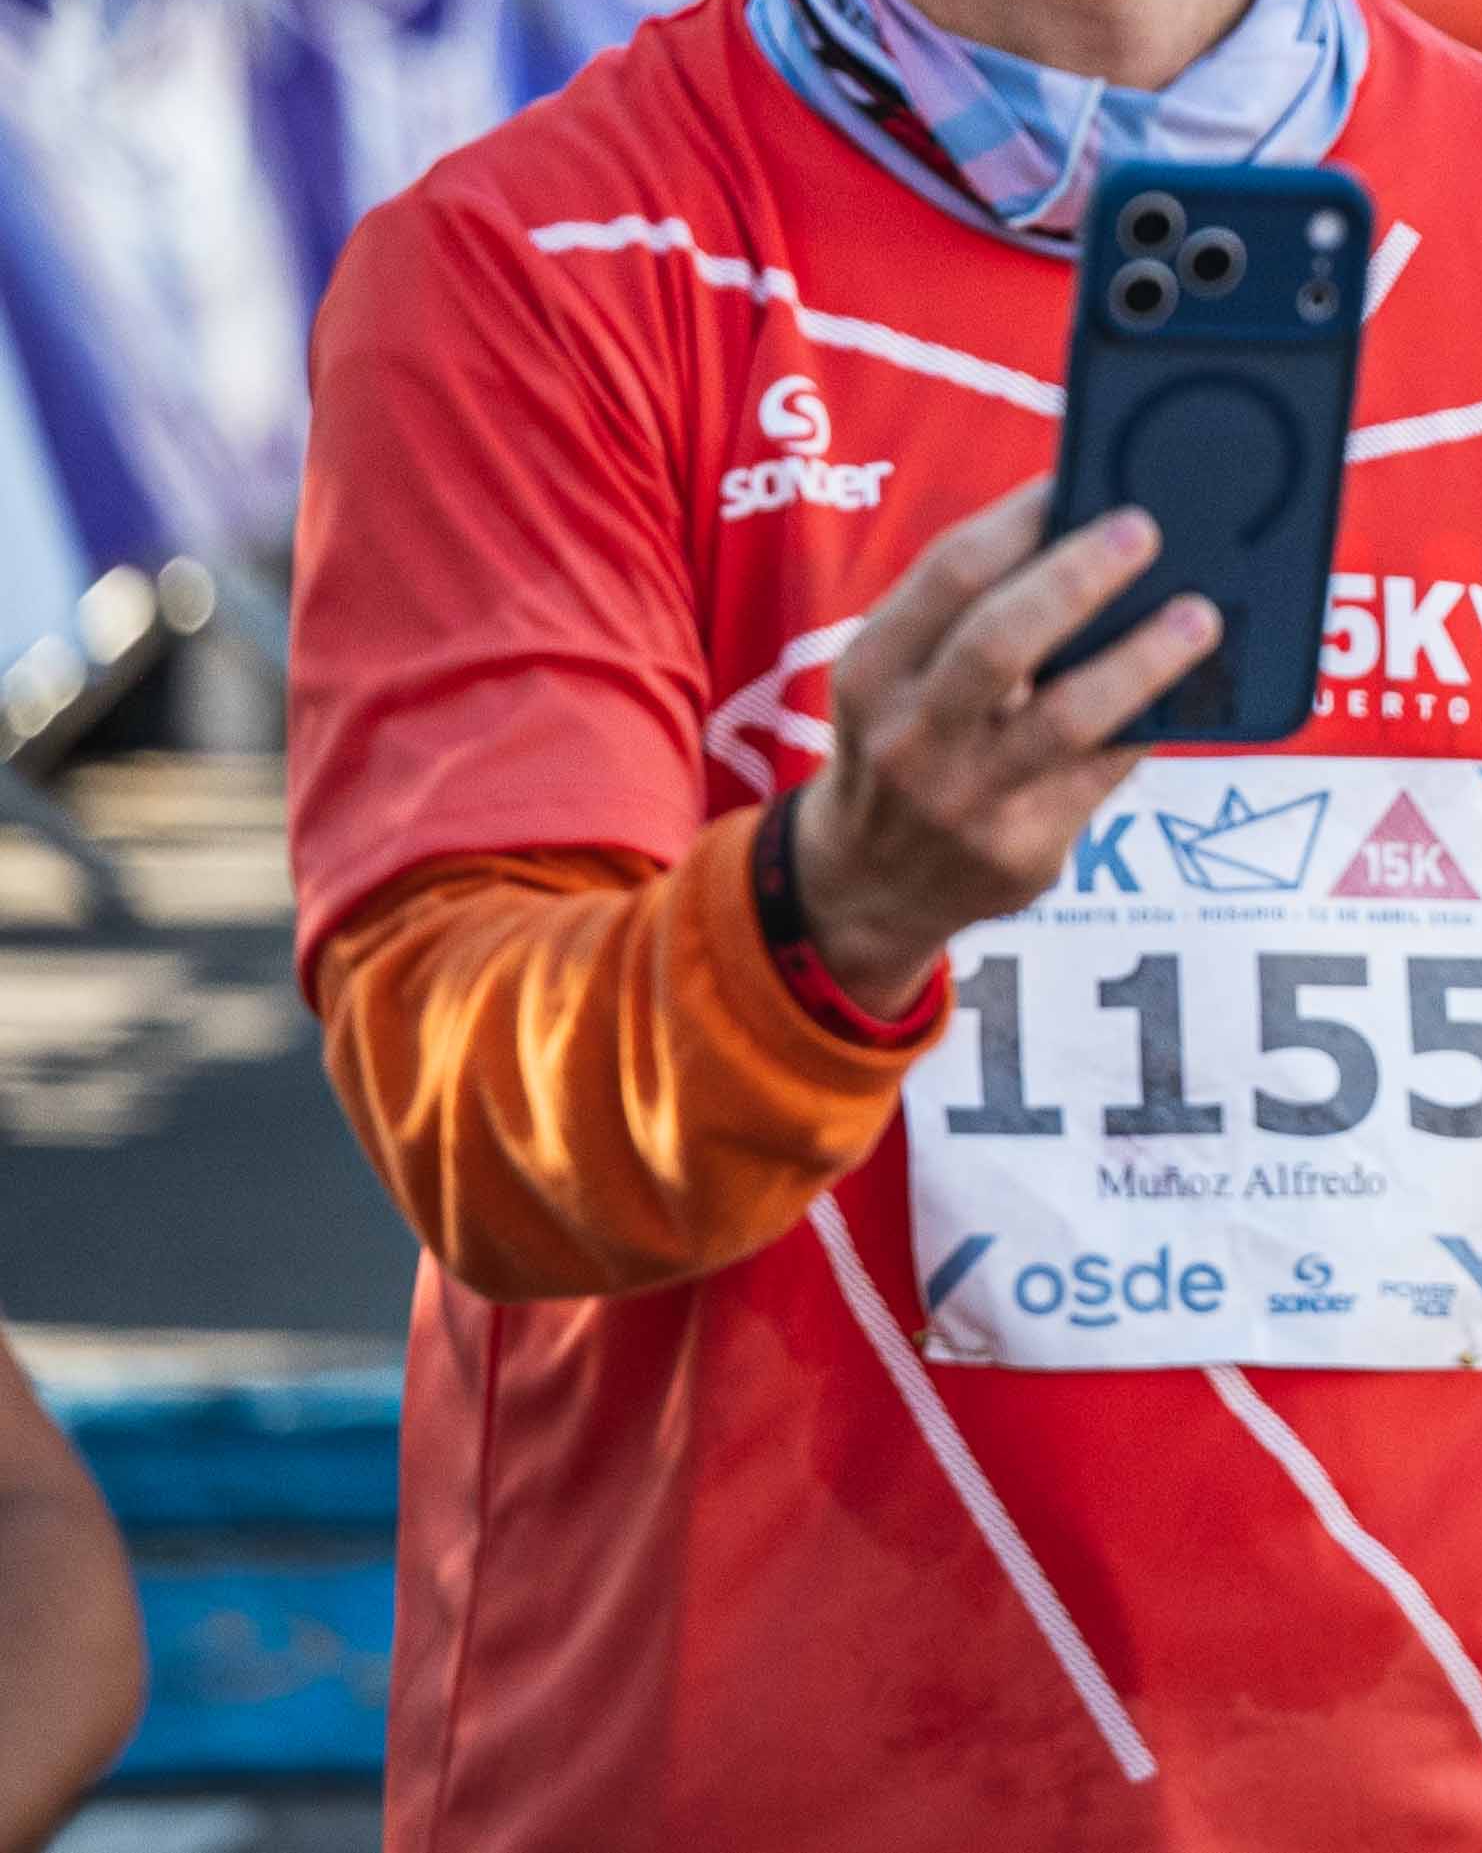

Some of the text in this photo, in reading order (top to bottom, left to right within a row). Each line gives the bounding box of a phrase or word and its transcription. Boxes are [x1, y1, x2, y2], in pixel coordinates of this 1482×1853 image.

[1317, 572, 1472, 686] 5K
[1312, 689, 1471, 725] UERTO
[1361, 840, 1446, 887] 15K
[1096, 1161, 1388, 1198] Muñoz Alfredo
[1014, 1245, 1225, 1328] osde
